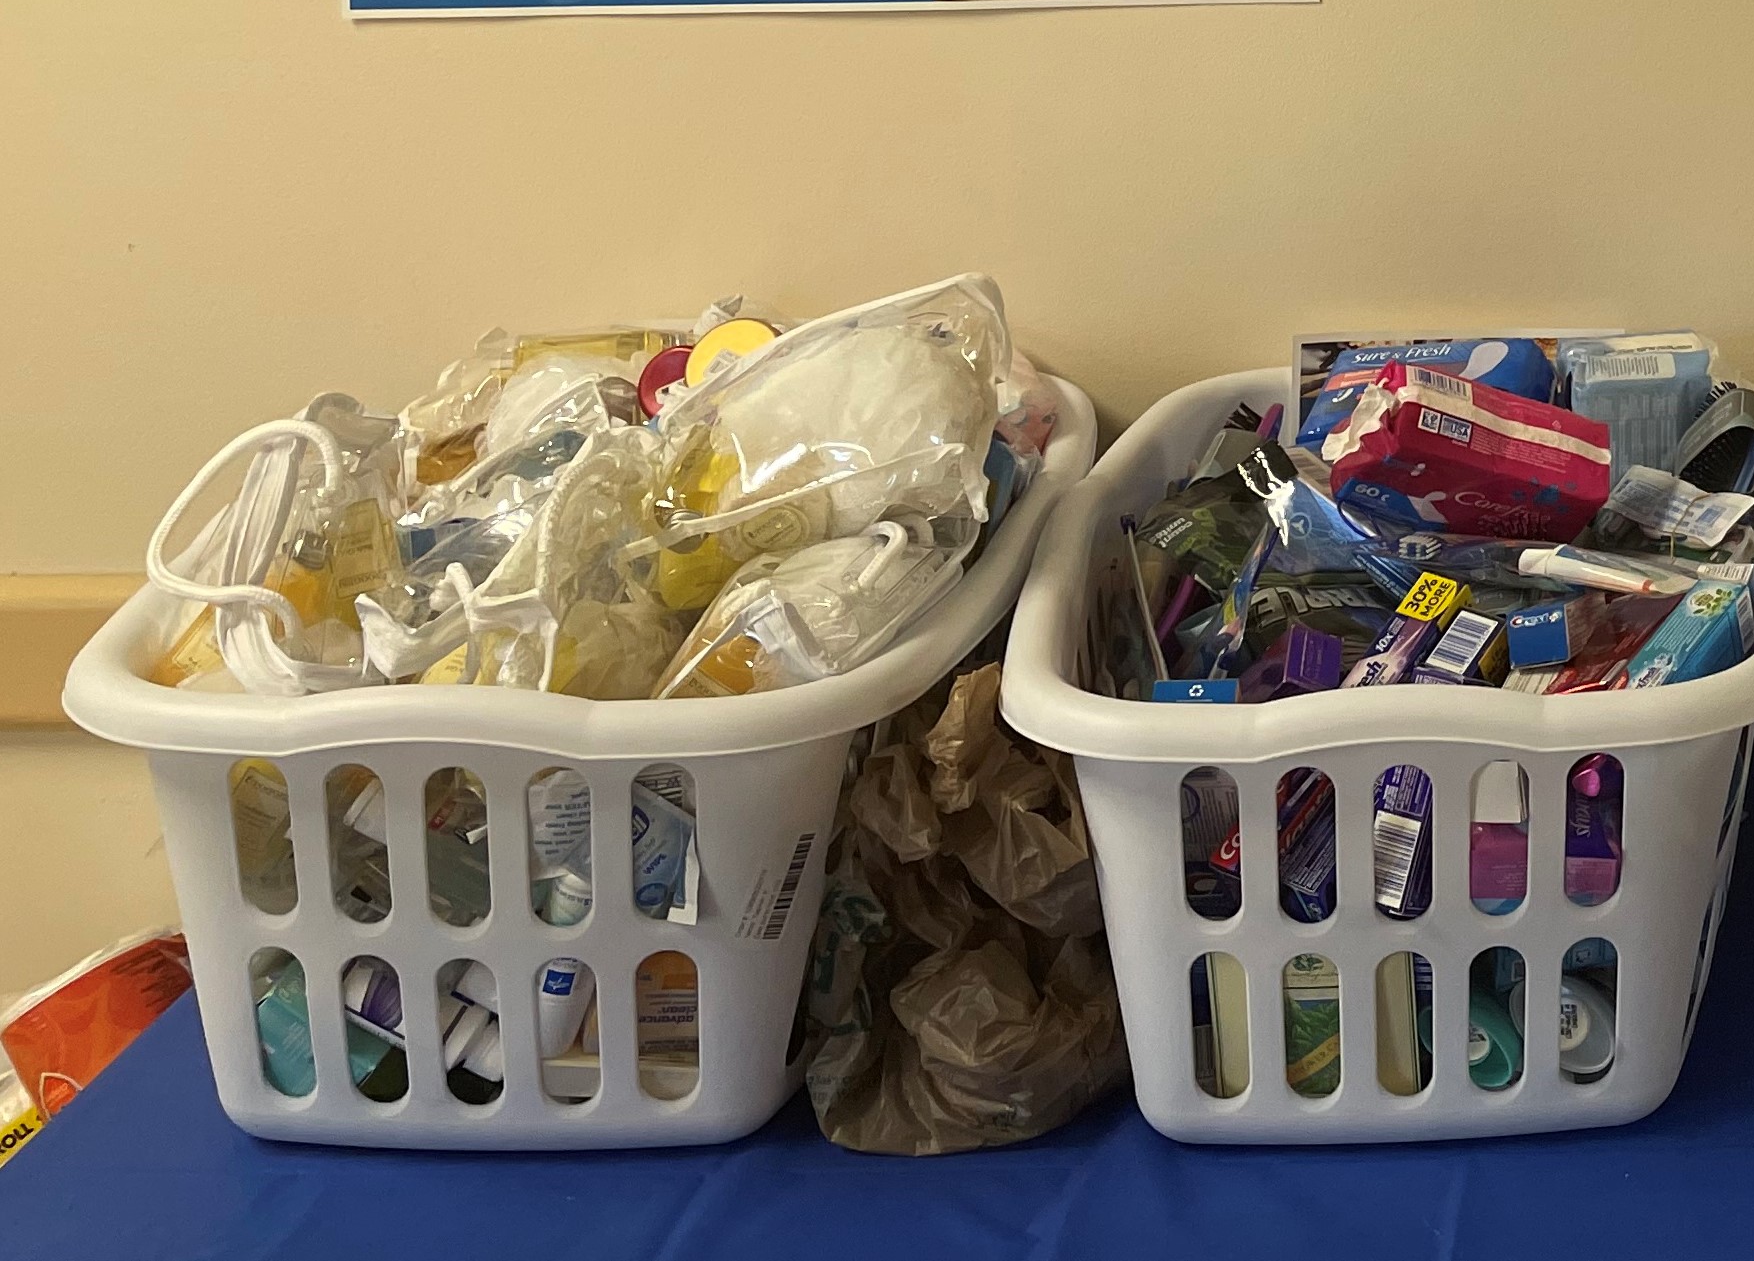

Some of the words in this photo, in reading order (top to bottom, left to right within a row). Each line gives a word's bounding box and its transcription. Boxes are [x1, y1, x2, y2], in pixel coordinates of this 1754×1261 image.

[1351, 351, 1390, 363] Sure
[1405, 344, 1452, 358] Fresh
[1450, 424, 1469, 438] USA
[1404, 578, 1438, 612] 30%
[1420, 581, 1452, 616] MORE
[1375, 632, 1395, 652] 10x
